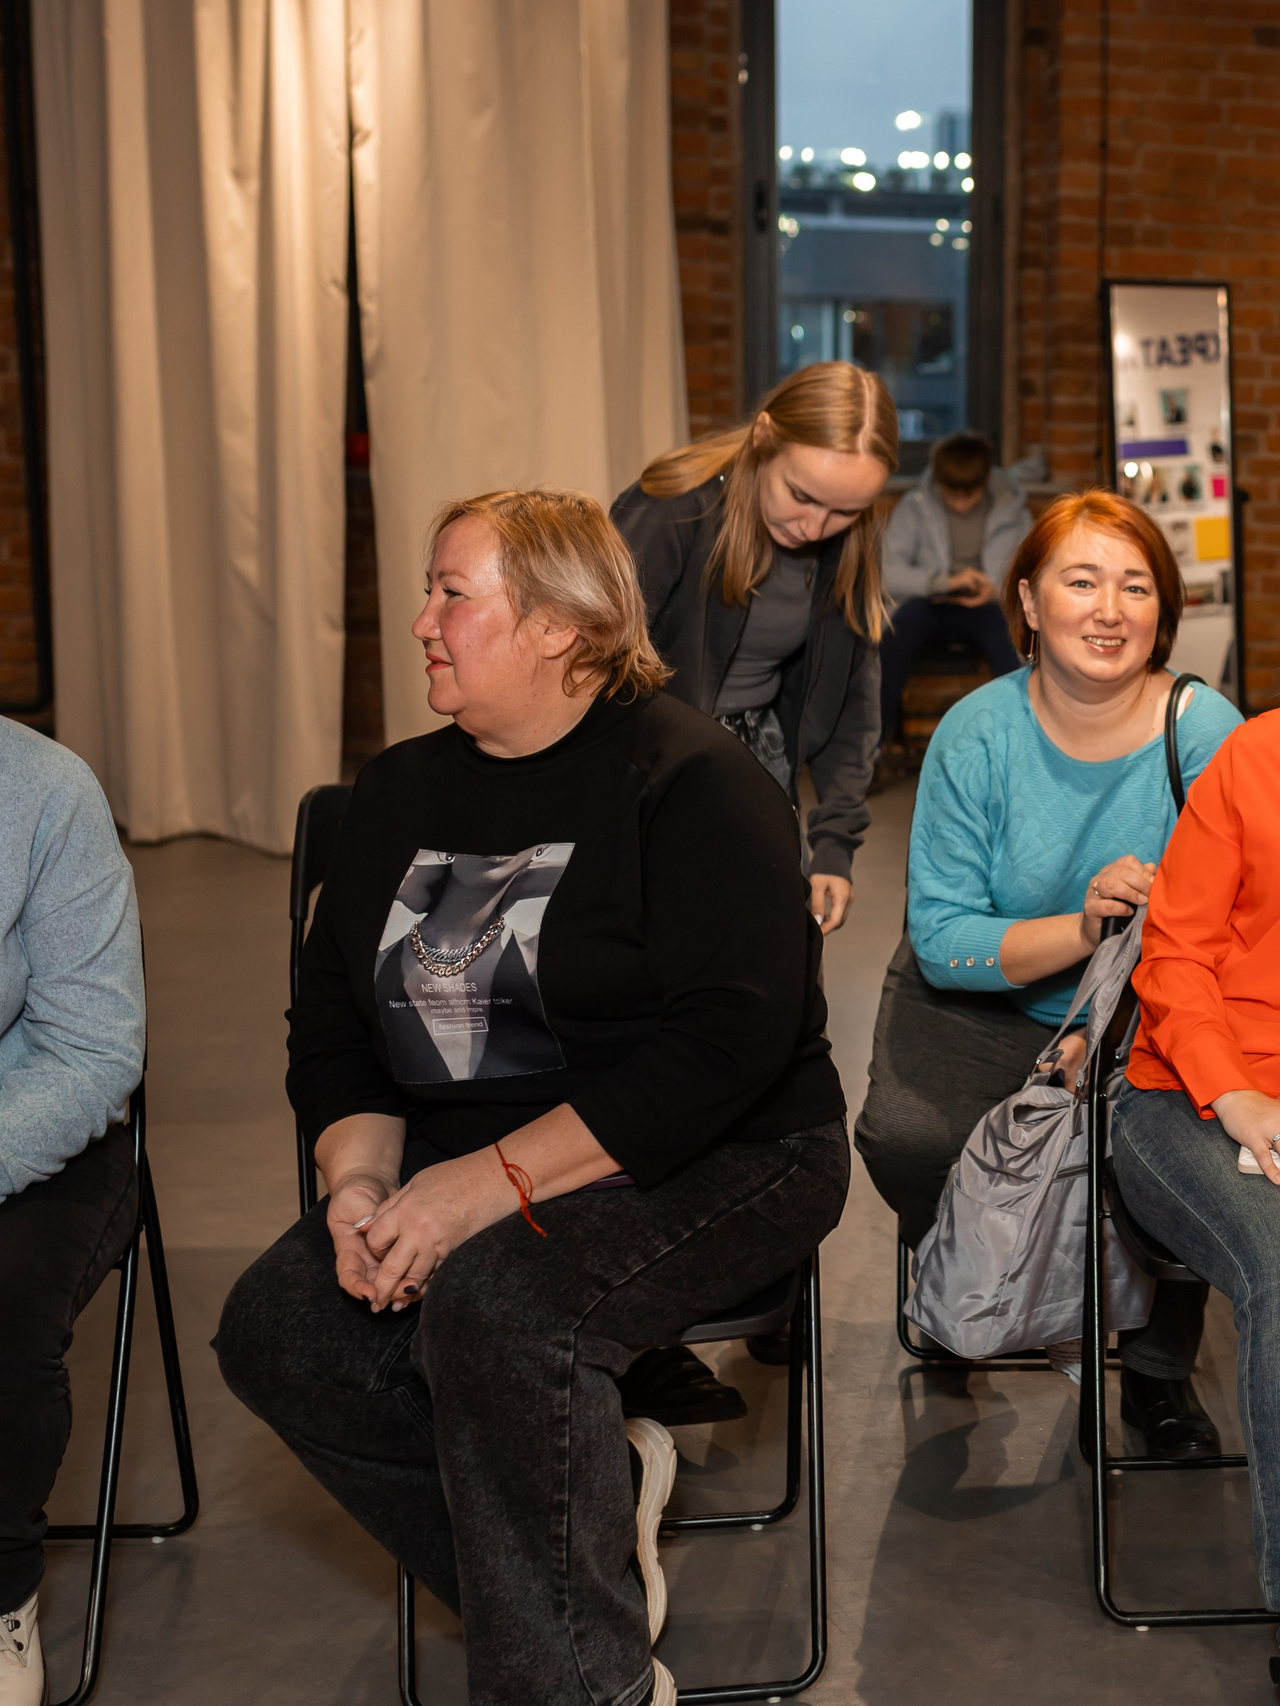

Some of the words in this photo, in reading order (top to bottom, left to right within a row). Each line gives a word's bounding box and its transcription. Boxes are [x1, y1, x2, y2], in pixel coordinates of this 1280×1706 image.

[421, 983, 441, 993] NEW
[443, 982, 478, 993] SHADES
[389, 1000, 407, 1009] New
[430, 1007, 452, 1016] maybe
[438, 1022, 465, 1030] fashion
